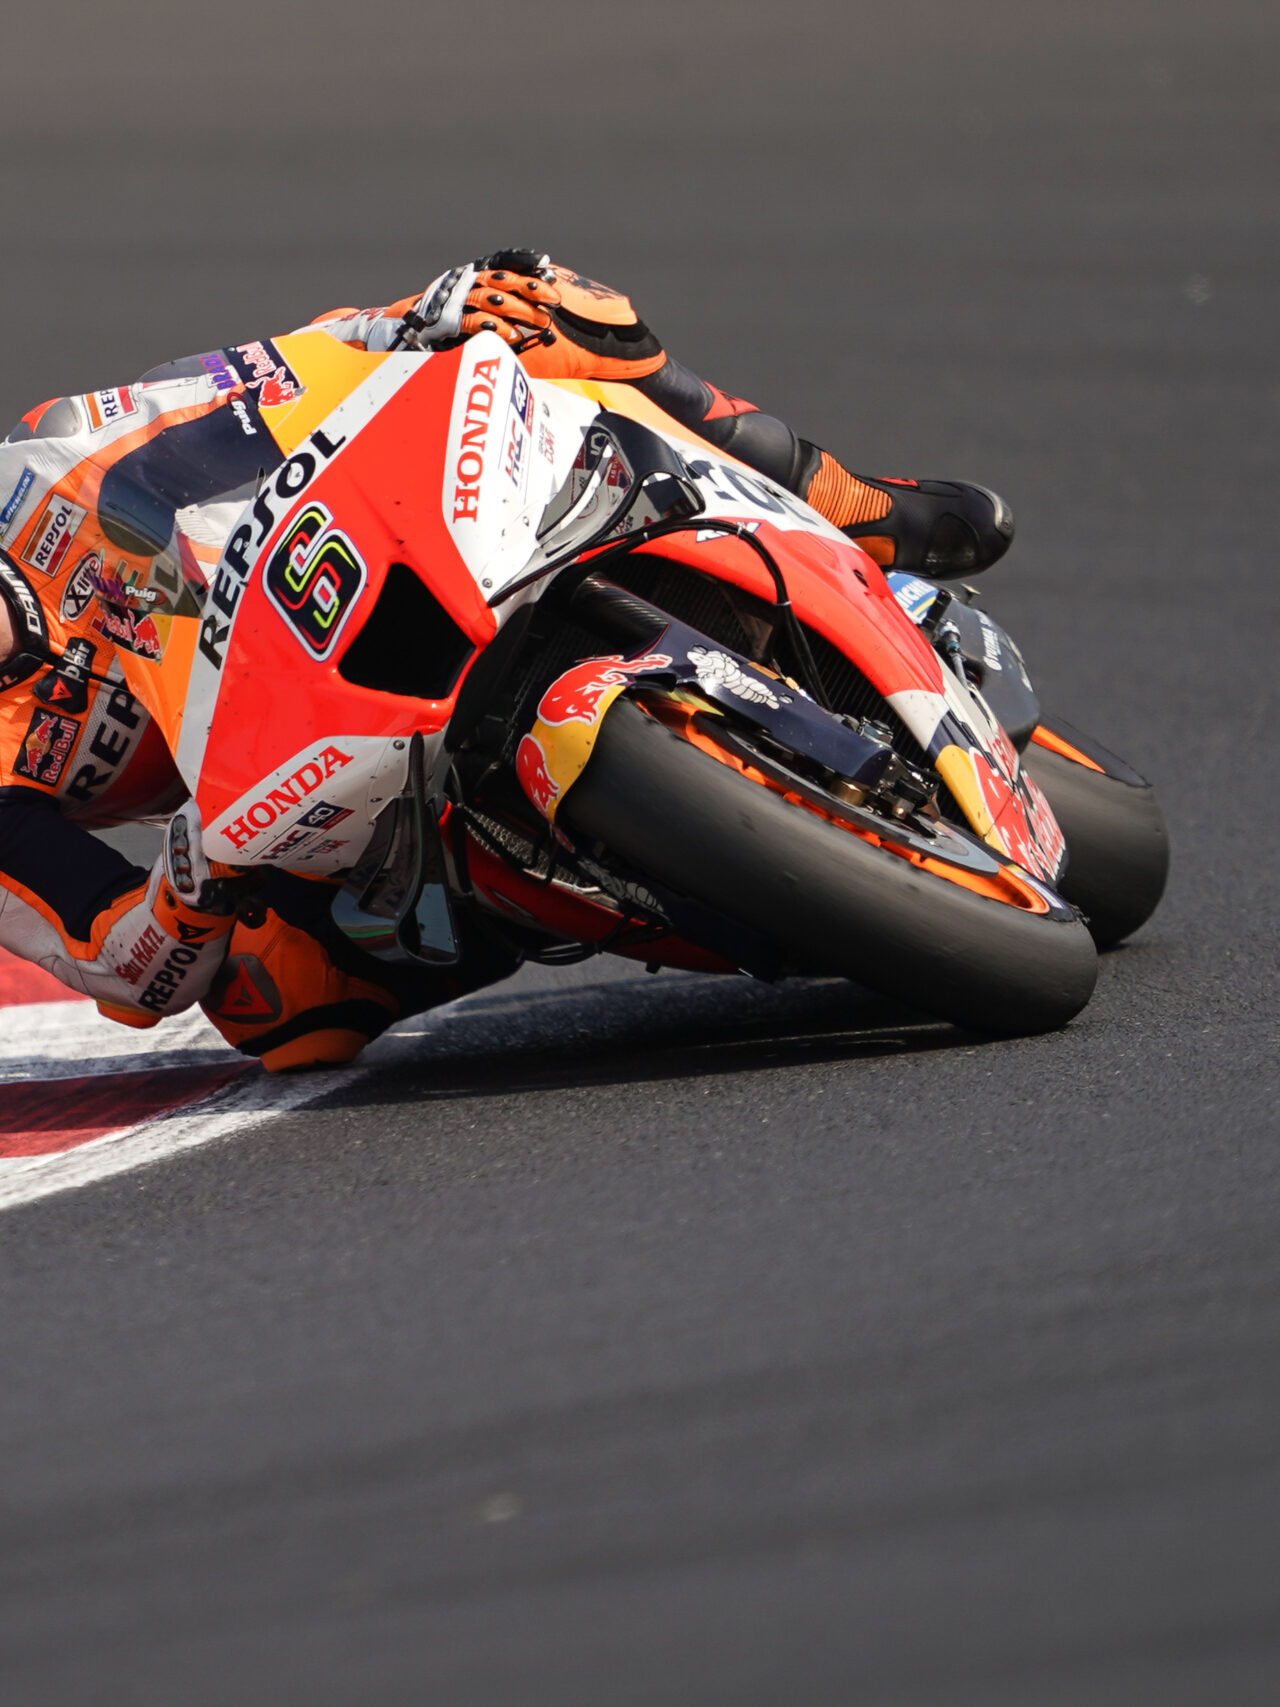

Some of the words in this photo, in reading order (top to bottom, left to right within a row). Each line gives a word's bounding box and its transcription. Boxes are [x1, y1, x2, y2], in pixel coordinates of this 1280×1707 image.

[231, 400, 258, 435] Puig
[453, 356, 502, 525] HONDA
[505, 419, 524, 487] HRC
[5, 475, 30, 521] MICHELIN
[35, 505, 72, 566] REPSOL
[199, 429, 347, 671] REPSOL
[126, 586, 158, 601] Puig
[262, 500, 375, 663] 6
[220, 745, 355, 849] HONDA
[308, 807, 335, 825] 40
